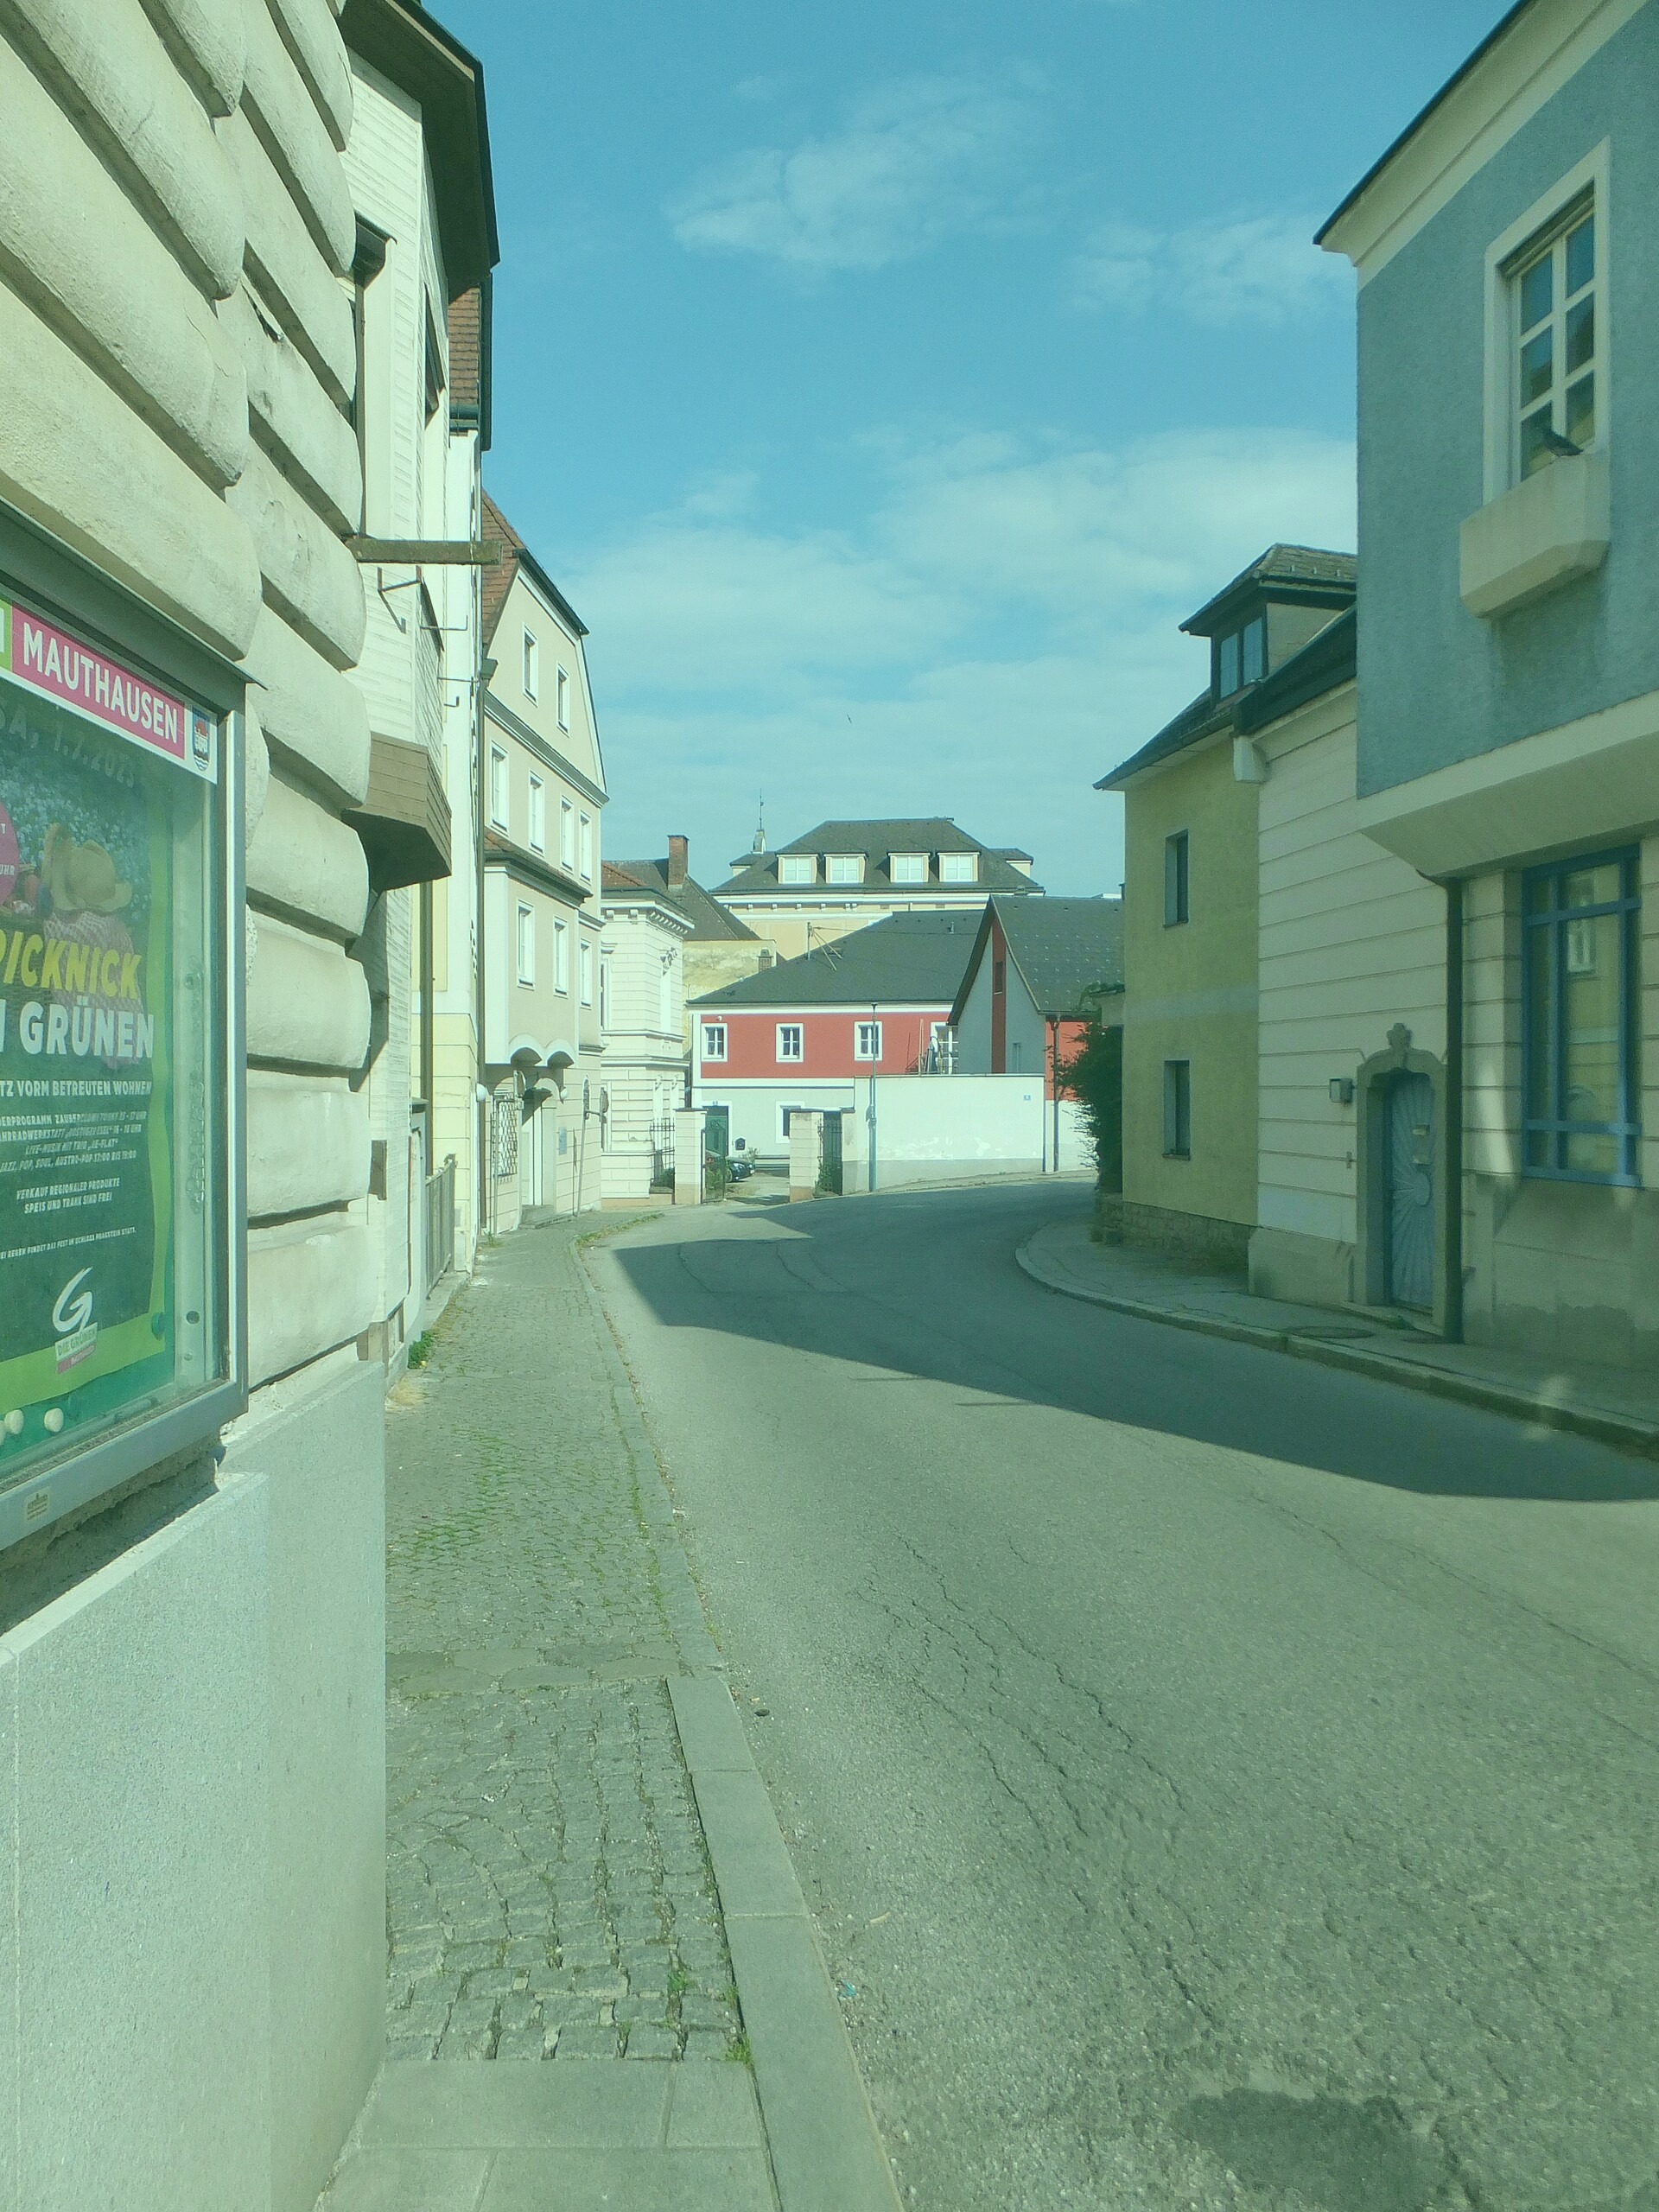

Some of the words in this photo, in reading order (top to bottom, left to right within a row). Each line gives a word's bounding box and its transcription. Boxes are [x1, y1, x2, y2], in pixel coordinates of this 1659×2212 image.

[23, 621, 178, 744] MAUTHAUSEN
[19, 995, 155, 1058] GRÜNEN
[16, 1080, 50, 1097] VORM
[52, 1080, 111, 1096] BETREUTEN
[113, 1080, 153, 1096] WOHNEN
[16, 1185, 48, 1200] VERKAUF
[49, 1181, 87, 1196] REGIONALER
[88, 1177, 121, 1191] PRODUKTE
[24, 1201, 46, 1214] SPEIS
[47, 1199, 61, 1211] UND
[62, 1196, 82, 1208] TRANK
[83, 1193, 97, 1205] SIND
[98, 1191, 112, 1203] FREI
